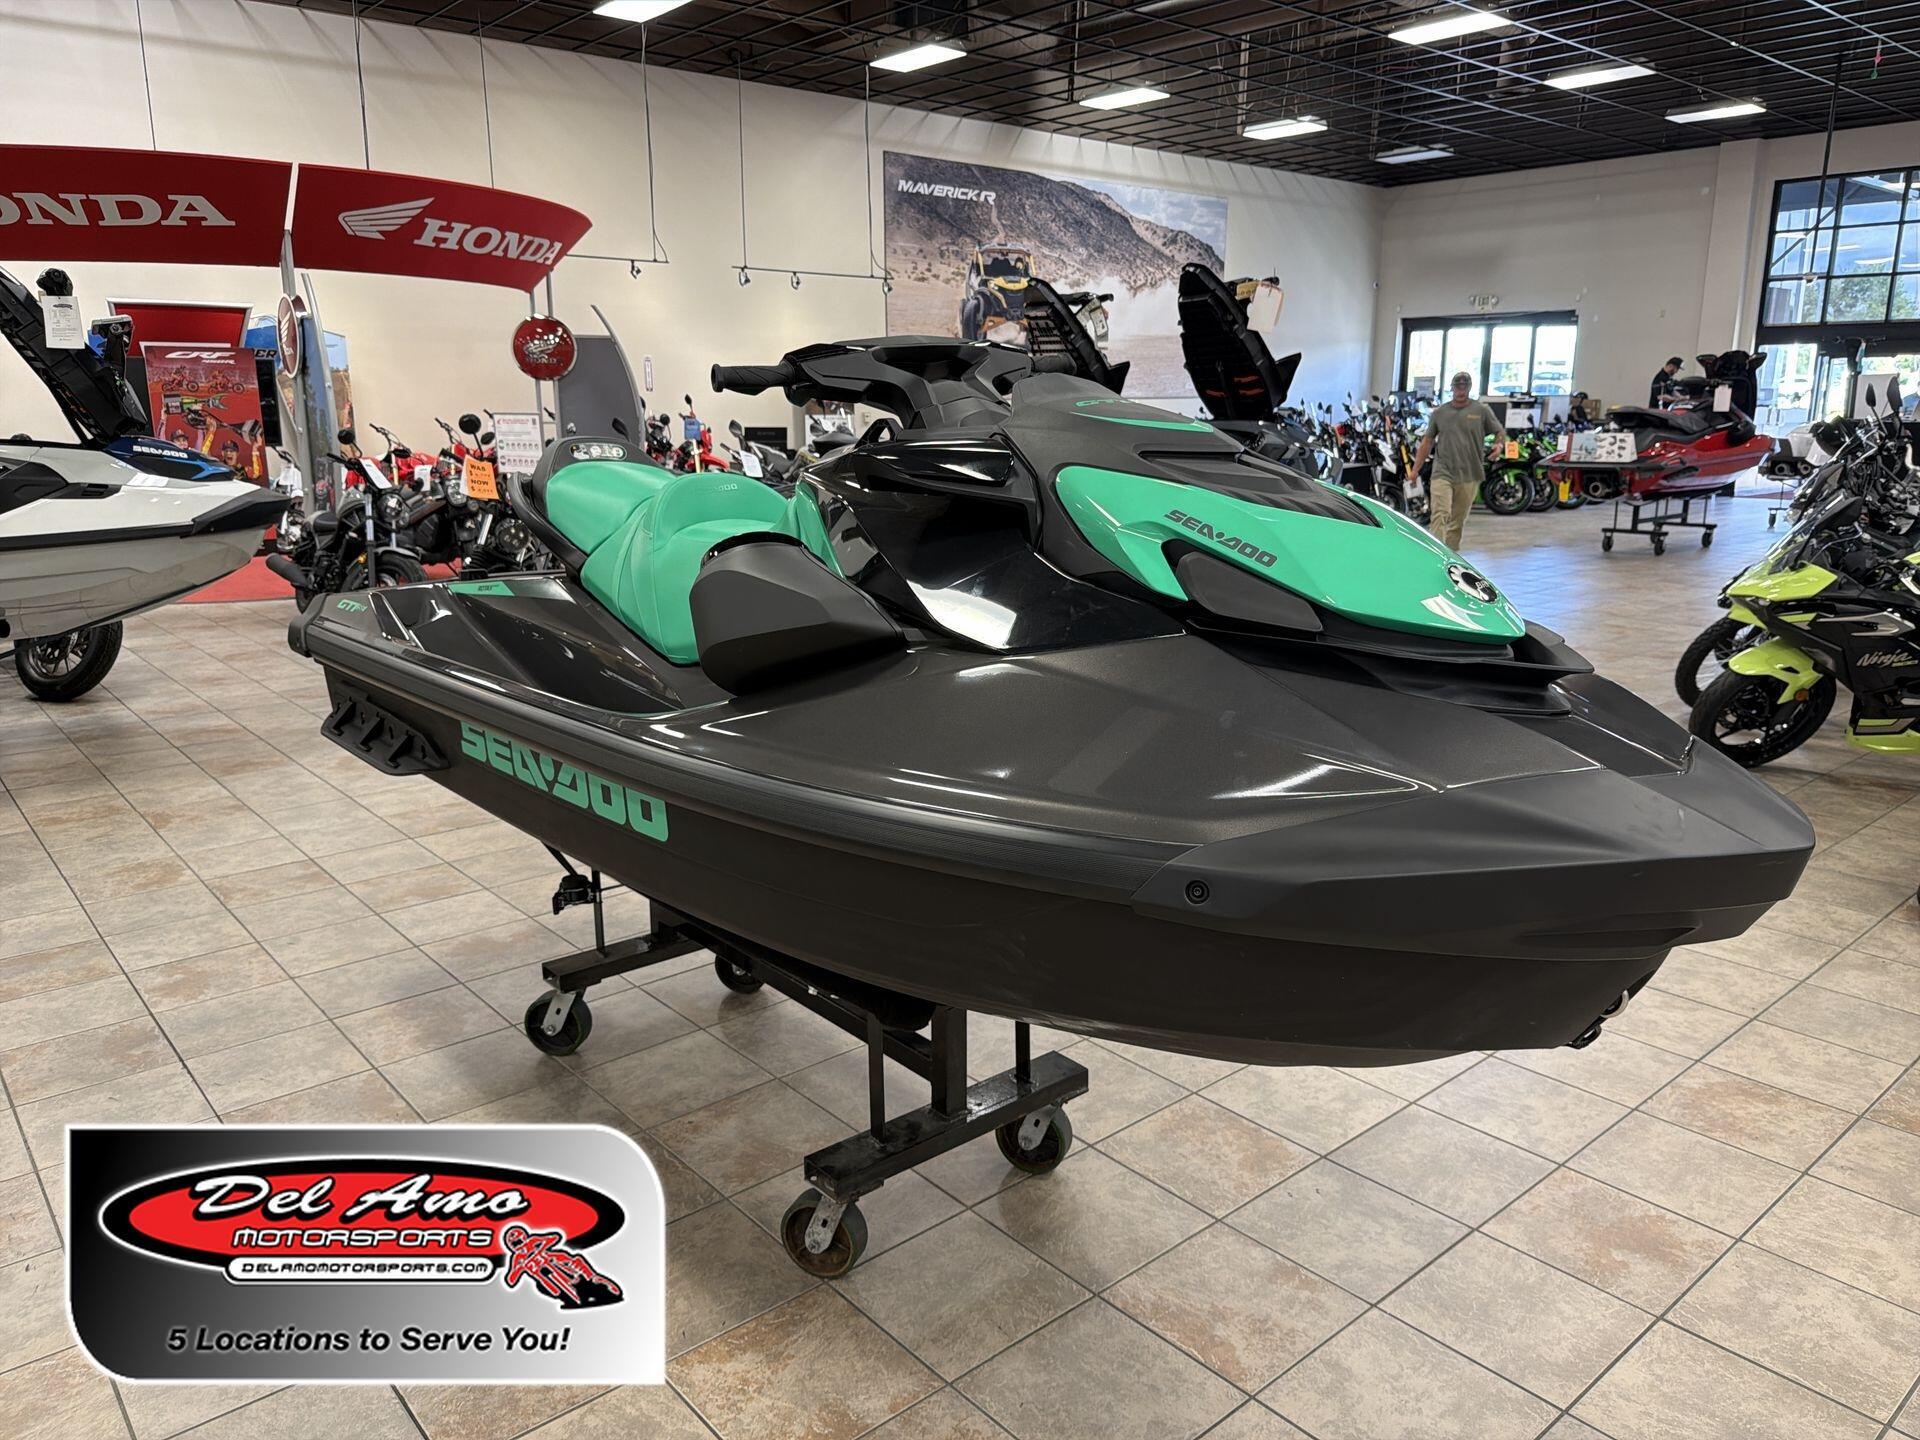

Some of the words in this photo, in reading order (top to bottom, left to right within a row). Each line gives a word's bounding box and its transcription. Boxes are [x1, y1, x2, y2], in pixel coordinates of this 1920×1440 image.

[897, 179, 980, 201] MAVERICK
[980, 190, 997, 205] R
[413, 217, 563, 265] HONDA
[165, 351, 236, 359] CRF
[469, 463, 486, 472] WAS
[1856, 648, 1912, 668] Ninja
